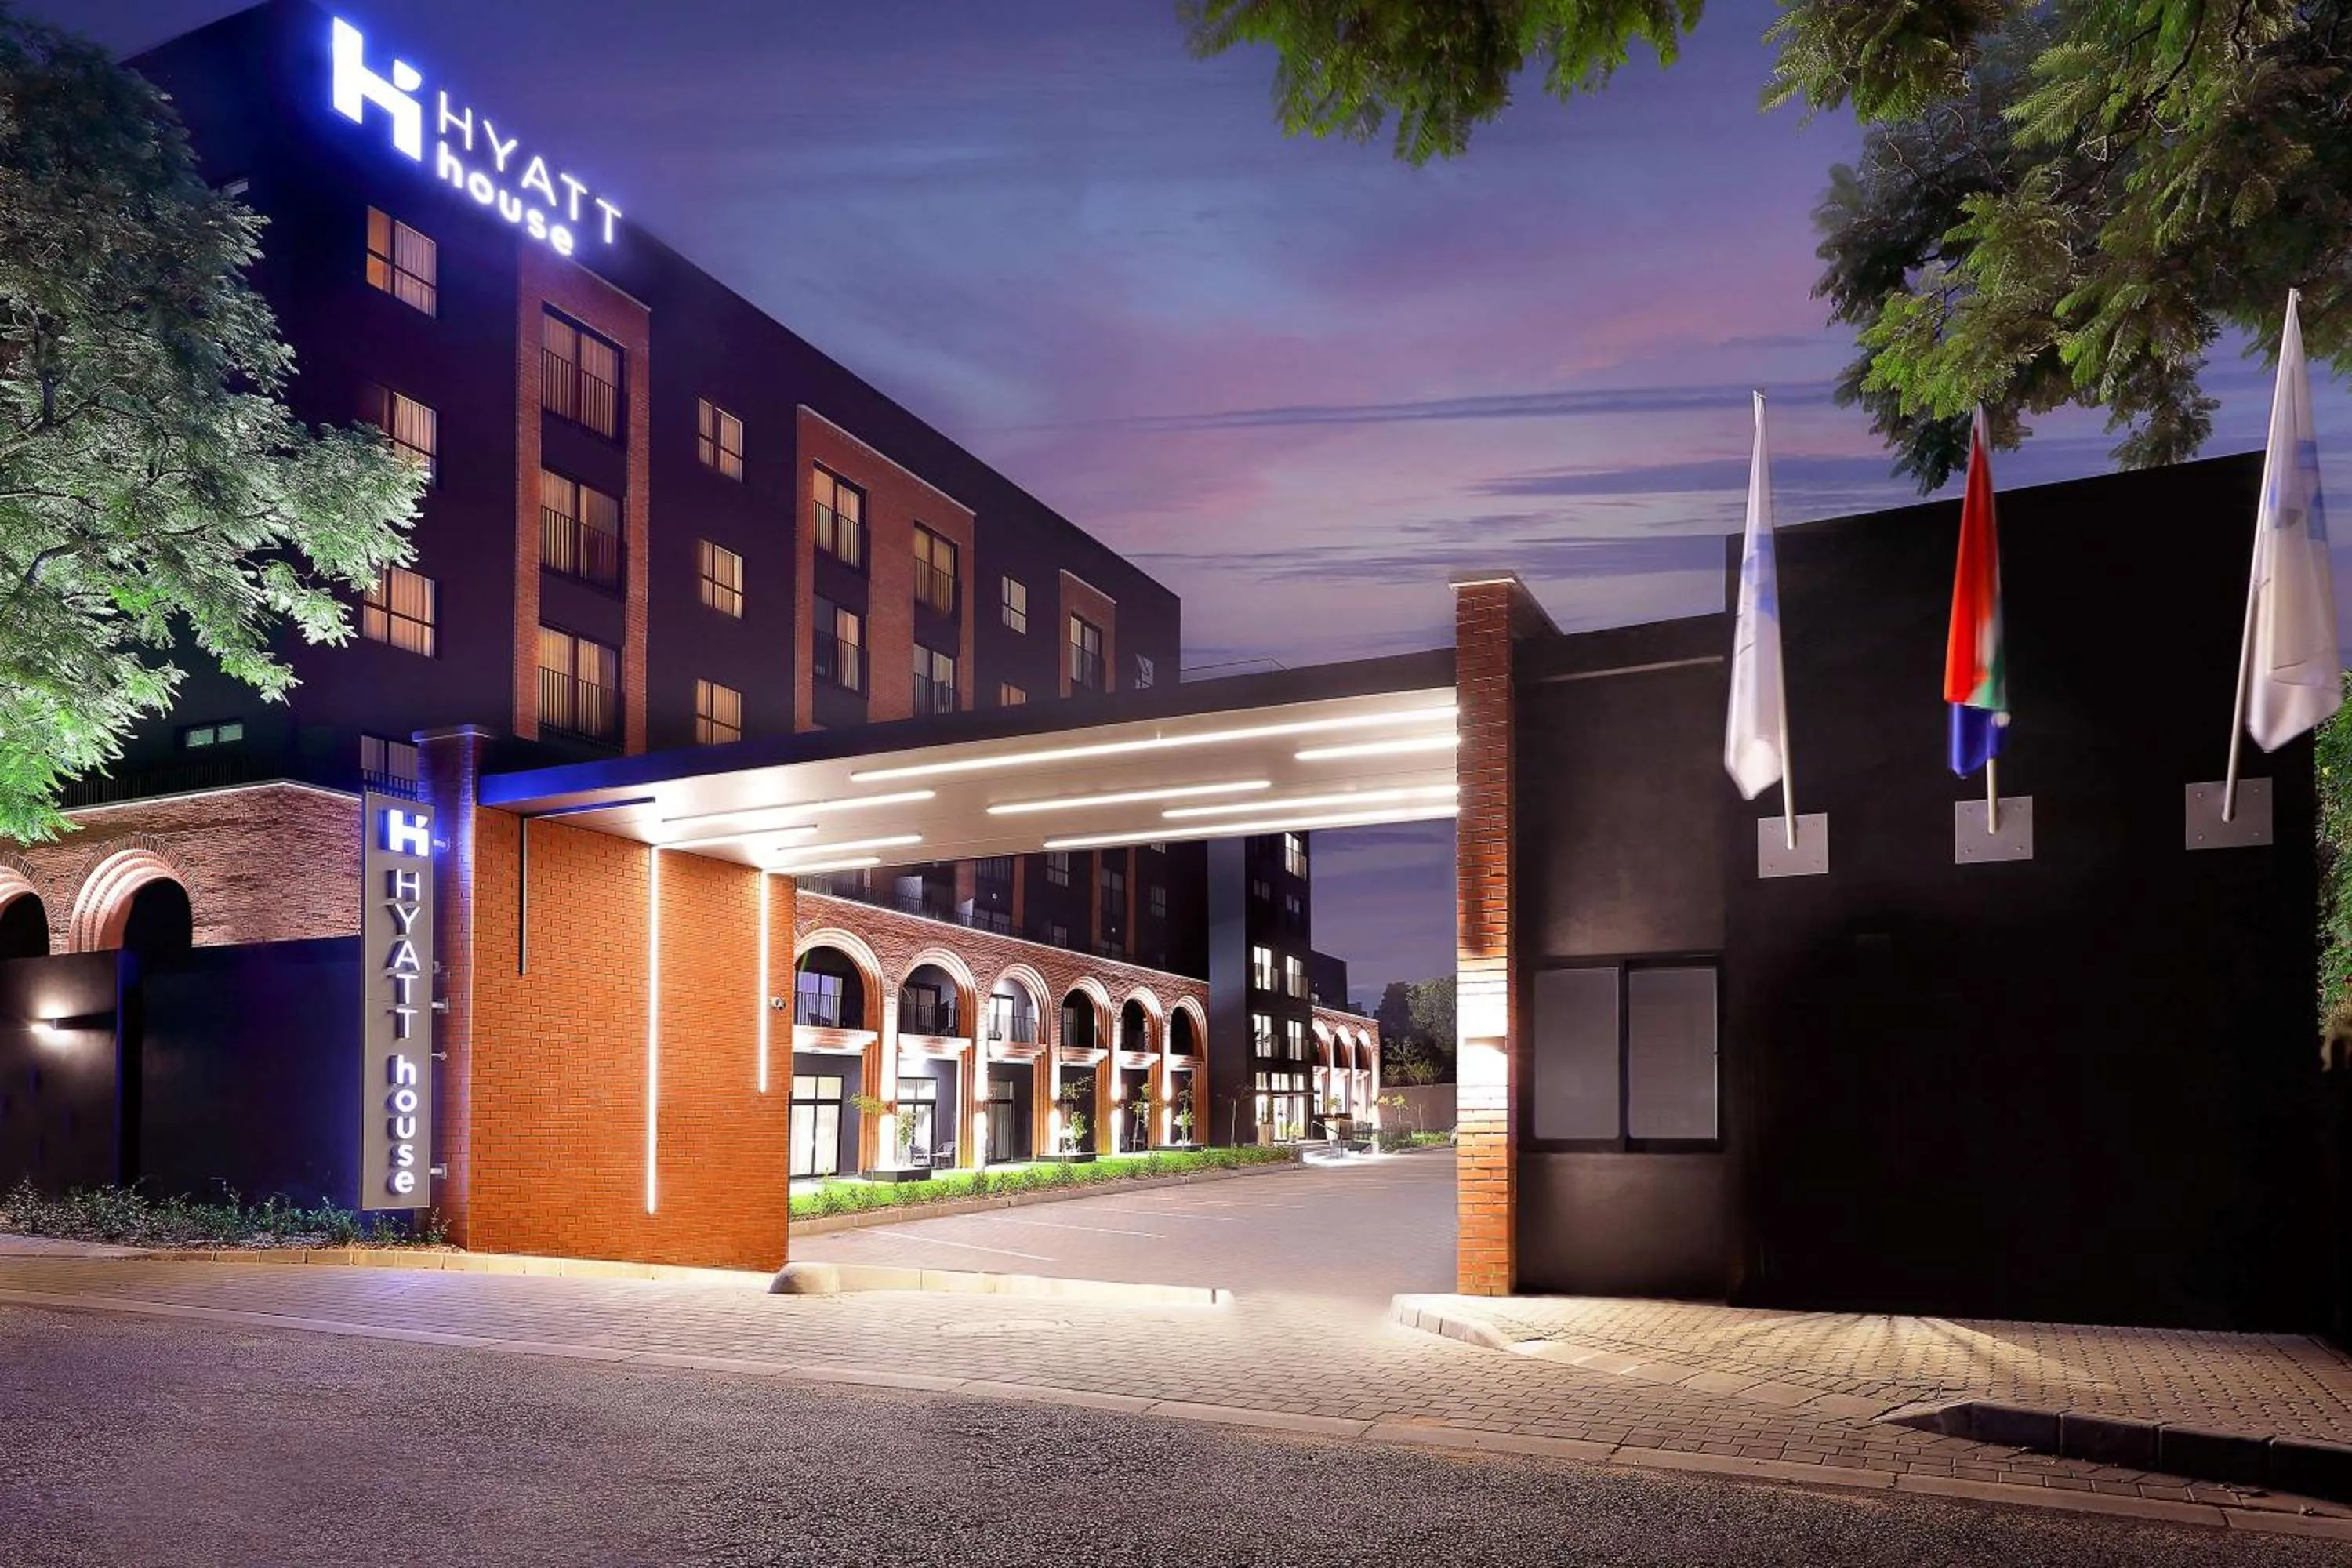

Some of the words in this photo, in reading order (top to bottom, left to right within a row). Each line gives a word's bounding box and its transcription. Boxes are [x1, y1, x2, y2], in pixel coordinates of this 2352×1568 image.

[437, 140, 574, 256] house
[439, 89, 622, 245] HYATT
[394, 869, 421, 1039] HYATT
[394, 1054, 418, 1193] house
